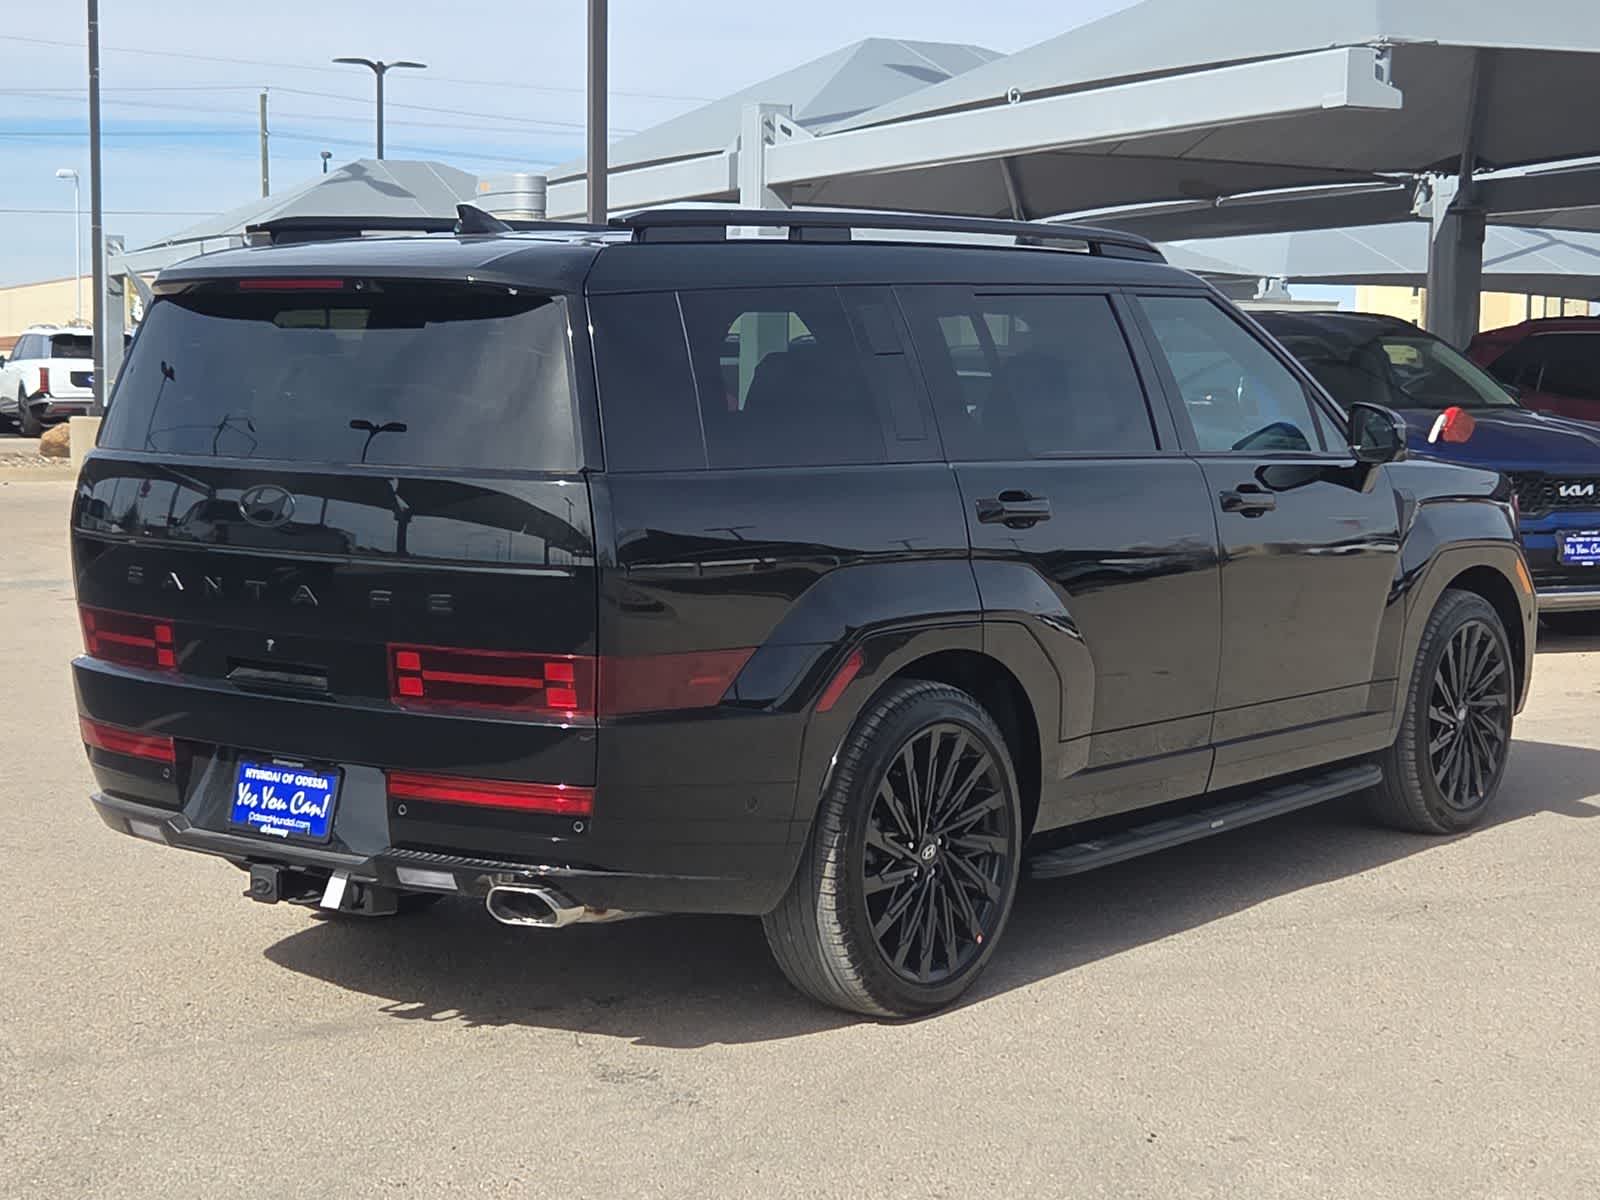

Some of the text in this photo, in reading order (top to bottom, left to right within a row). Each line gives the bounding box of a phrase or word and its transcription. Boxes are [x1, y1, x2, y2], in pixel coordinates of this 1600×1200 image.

[1559, 483, 1595, 497] KIA
[127, 565, 452, 613] SANTA FE
[245, 767, 328, 790] HYUNDAI OF ODESSA
[236, 782, 331, 819] Yes You Can!
